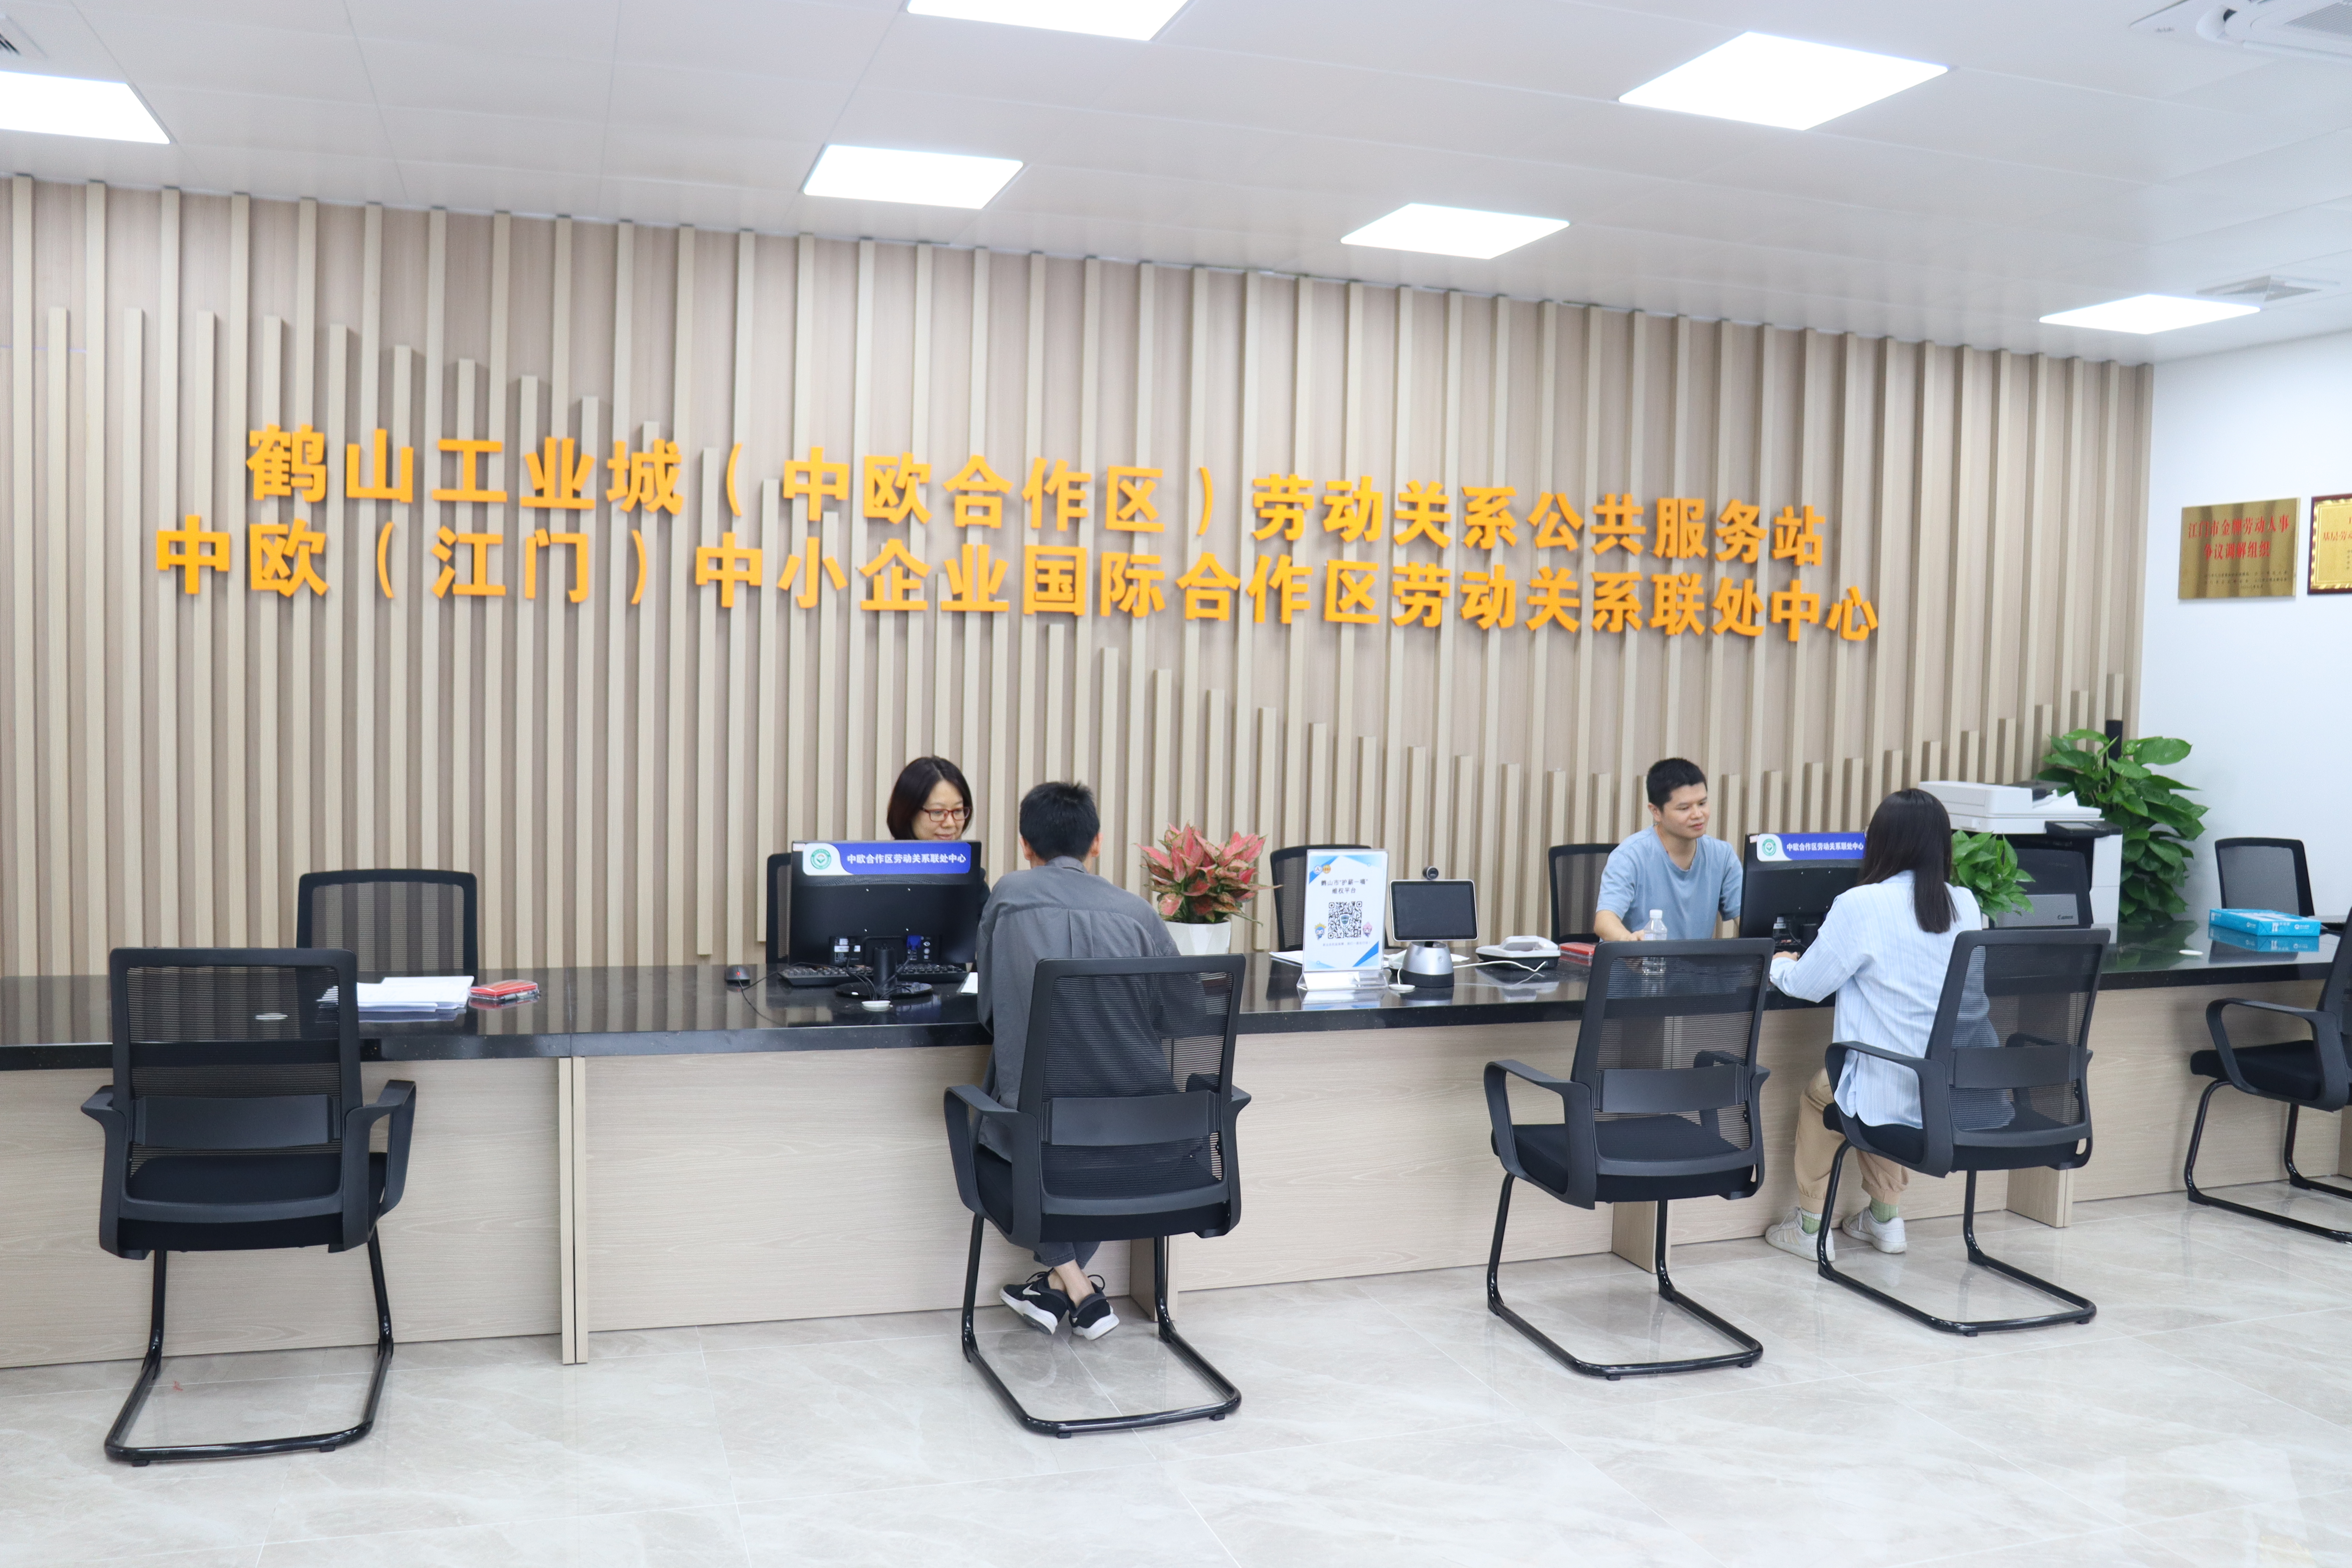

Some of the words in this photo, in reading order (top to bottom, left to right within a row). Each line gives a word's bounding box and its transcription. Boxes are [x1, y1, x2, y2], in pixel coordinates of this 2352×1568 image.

[247, 425, 1825, 566] 鹤山工业城（中欧合作区）劳动关系公共服务站
[2189, 515, 2289, 538] 江门市金牌劳动人事
[2203, 541, 2270, 560] 争议调解组织
[156, 515, 1878, 642] 中欧（江门）中小企业国际合作区劳动关系联处中心
[1787, 842, 1864, 851] 中欧合作区劳动关系联处中心
[847, 854, 966, 864] 中欧合作区劳动关系联处中心
